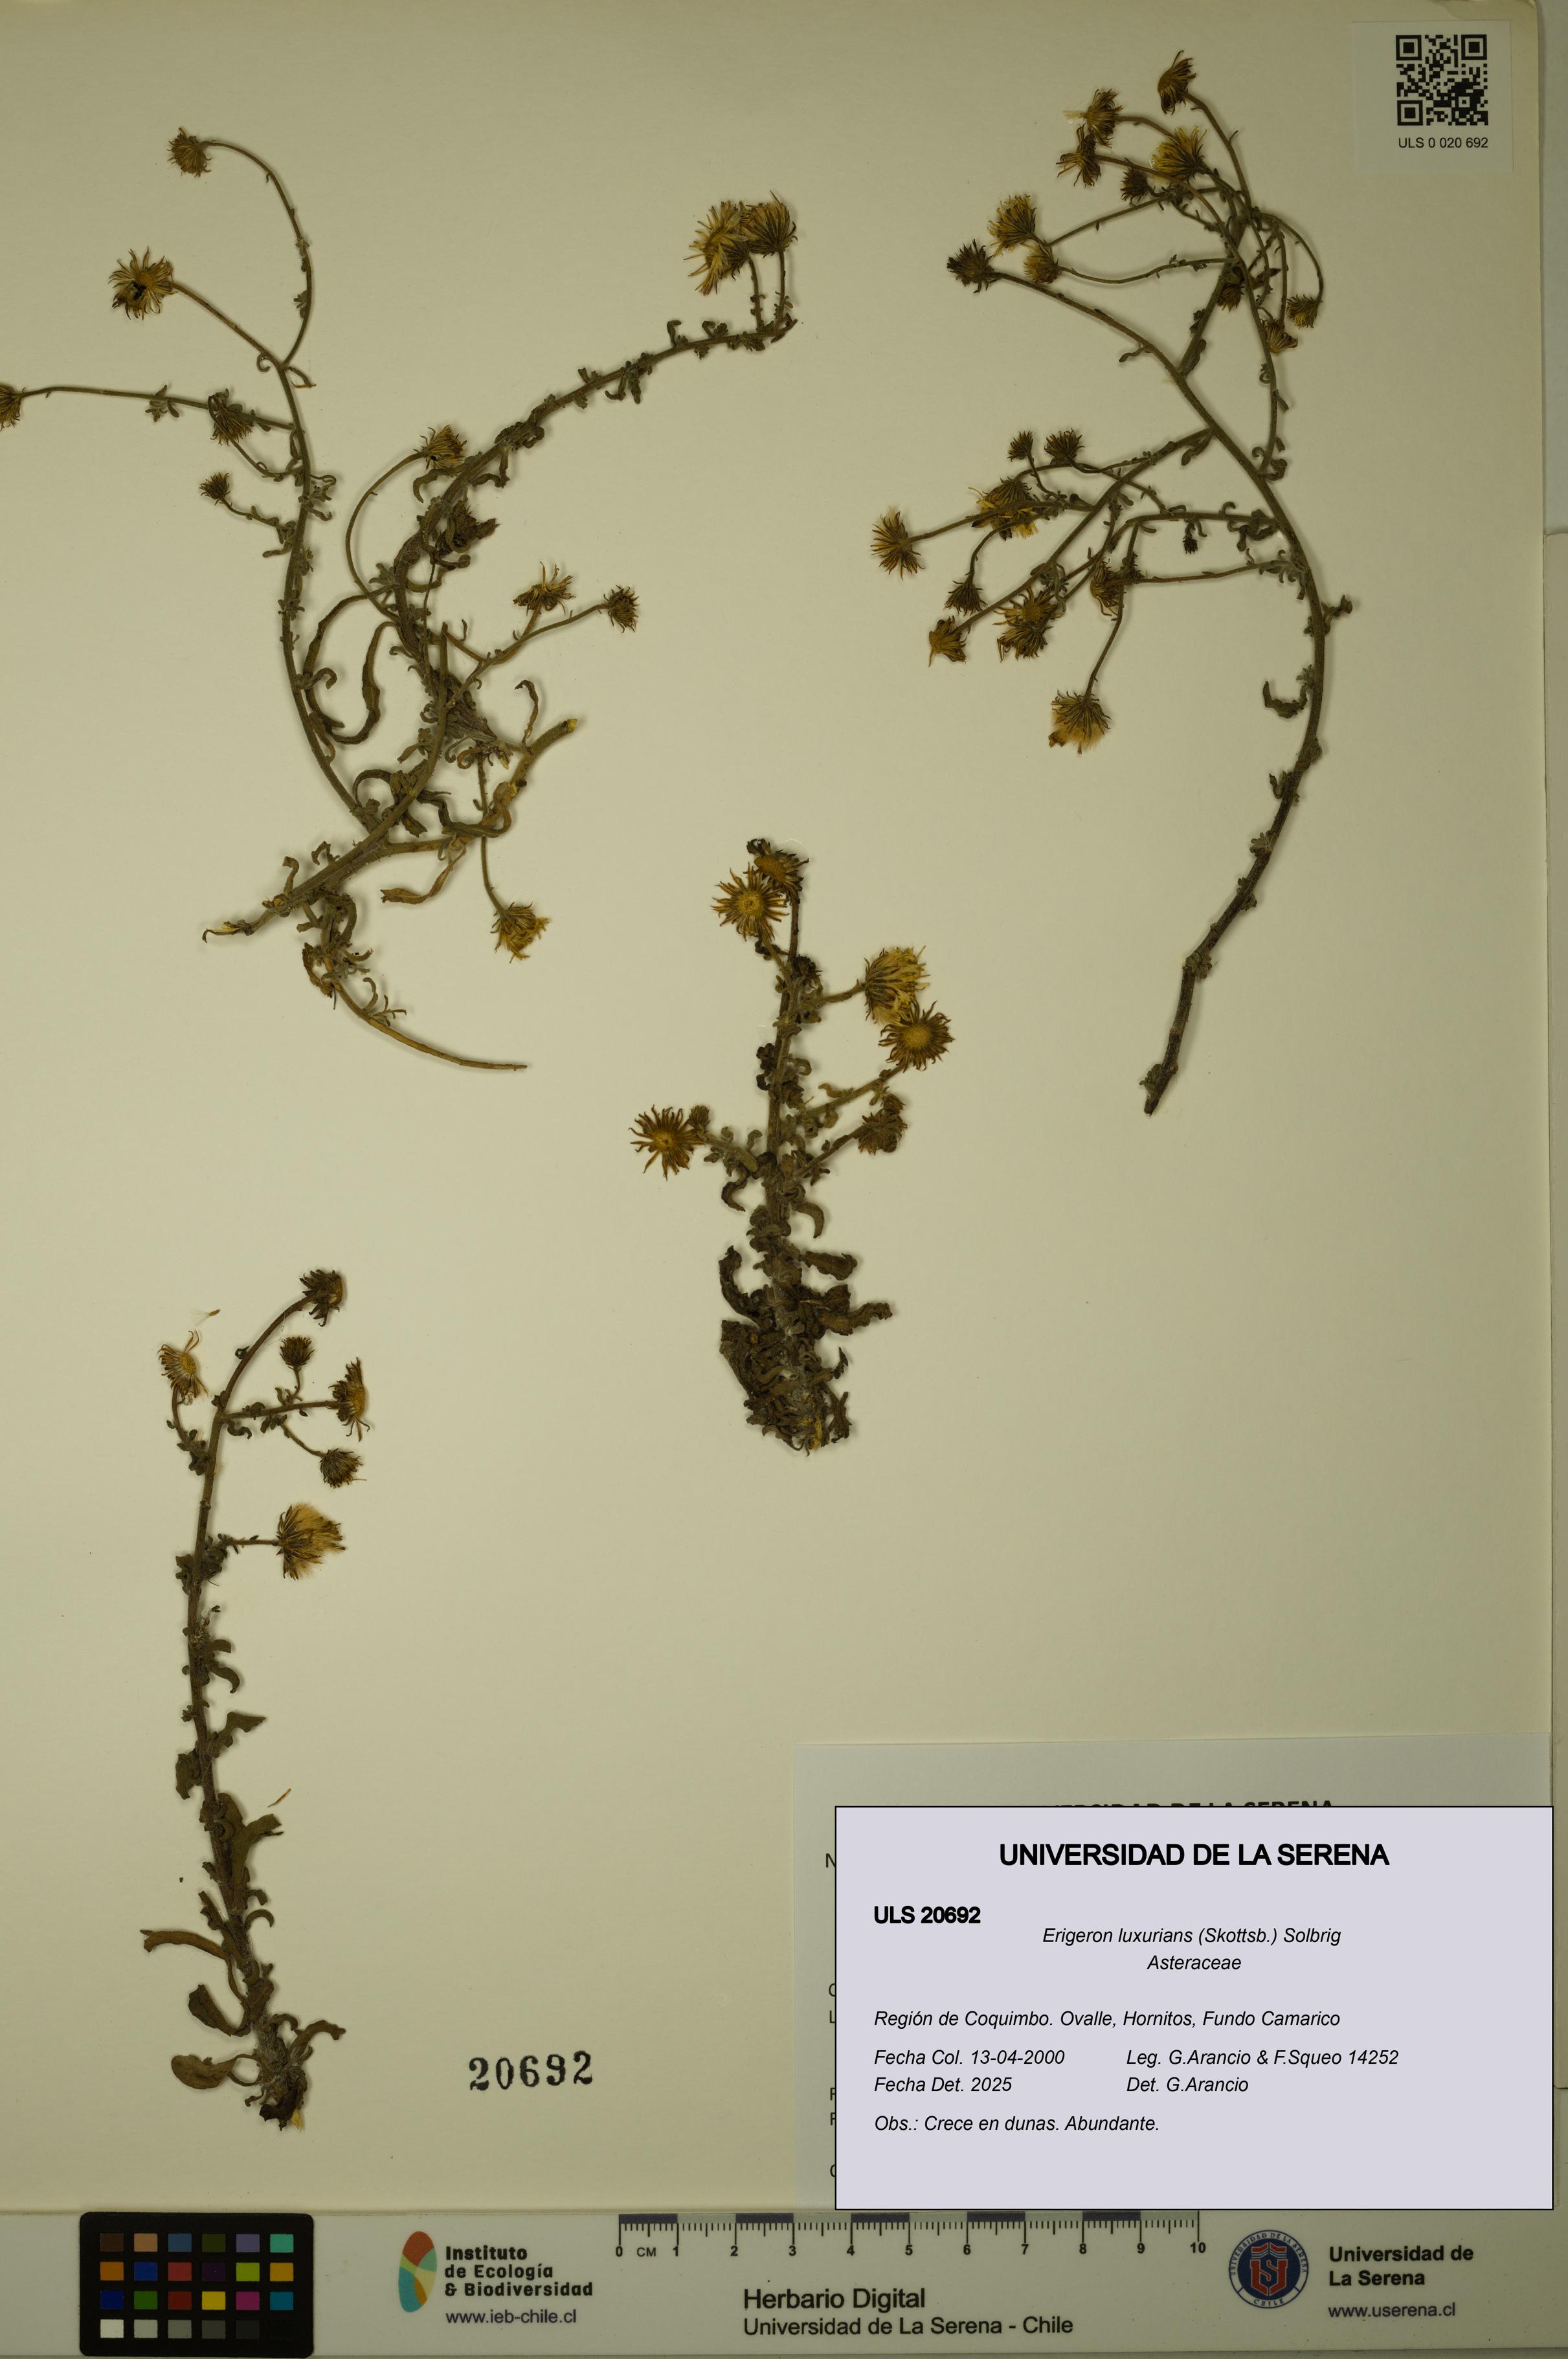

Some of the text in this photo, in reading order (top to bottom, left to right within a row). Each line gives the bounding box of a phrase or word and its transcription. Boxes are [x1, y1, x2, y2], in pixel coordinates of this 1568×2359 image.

[1398, 137, 1488, 148] ULS 0 020 692
[469, 2050, 593, 2091] 20692
[1282, 2235, 1292, 2244] LA
[445, 2244, 528, 2261] Instituto
[615, 2242, 1207, 2257] 0 CM 1 2 3 4 5 6 7 8 9 10
[1329, 2244, 1474, 2263] Universidad de
[444, 2263, 553, 2281] de Ecología
[1329, 2270, 1425, 2286] La Serena
[445, 2281, 593, 2297] & Biodiversidad
[744, 2287, 925, 2314] Herbario Digital
[445, 2309, 576, 2323] www.ieb-chile.cl
[1328, 2301, 1455, 2318] www.userena.cl
[744, 2317, 861, 2336] Universidad
[868, 2317, 893, 2335] de
[899, 2317, 924, 2335] La
[930, 2316, 1002, 2334] Serena
[1022, 2316, 1073, 2334] Chile
